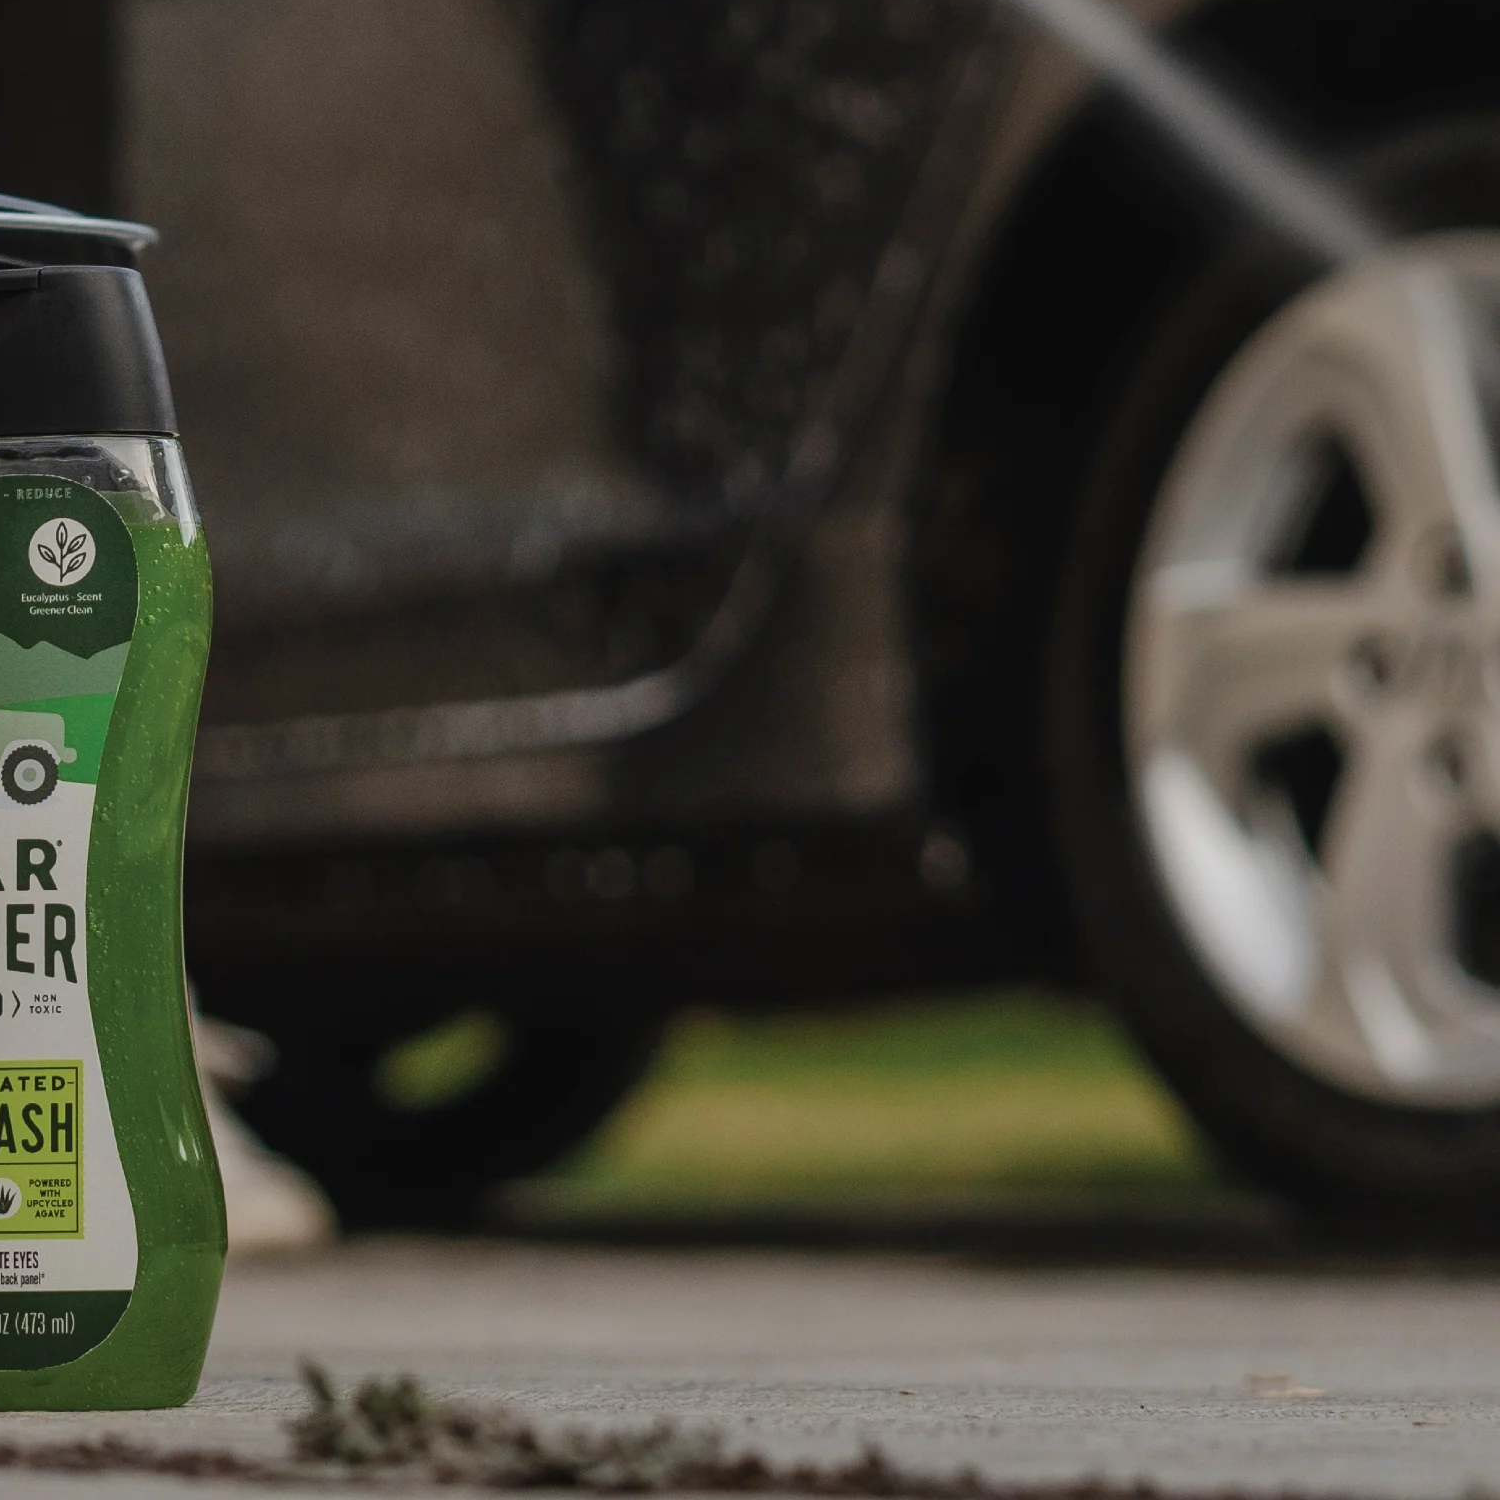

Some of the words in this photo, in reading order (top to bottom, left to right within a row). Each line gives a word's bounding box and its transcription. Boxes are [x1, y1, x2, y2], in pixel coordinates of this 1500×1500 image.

[17, 487, 72, 500] REDUCE
[21, 593, 69, 604] Eucalyptus
[76, 592, 102, 602] Scent
[29, 606, 65, 615] Greener
[66, 605, 93, 615] Clean
[34, 994, 57, 1003] NON
[29, 1005, 62, 1014] TOXIC
[29, 1178, 72, 1188] POWERED
[40, 1189, 61, 1198] WITH
[26, 1199, 74, 1208] UPCYCLED
[35, 1209, 66, 1218] AGAVE
[13, 1251, 39, 1269] EYES
[0, 1272, 19, 1285] back
[14, 1311, 46, 1335] (473
[51, 1311, 75, 1335] ml)
